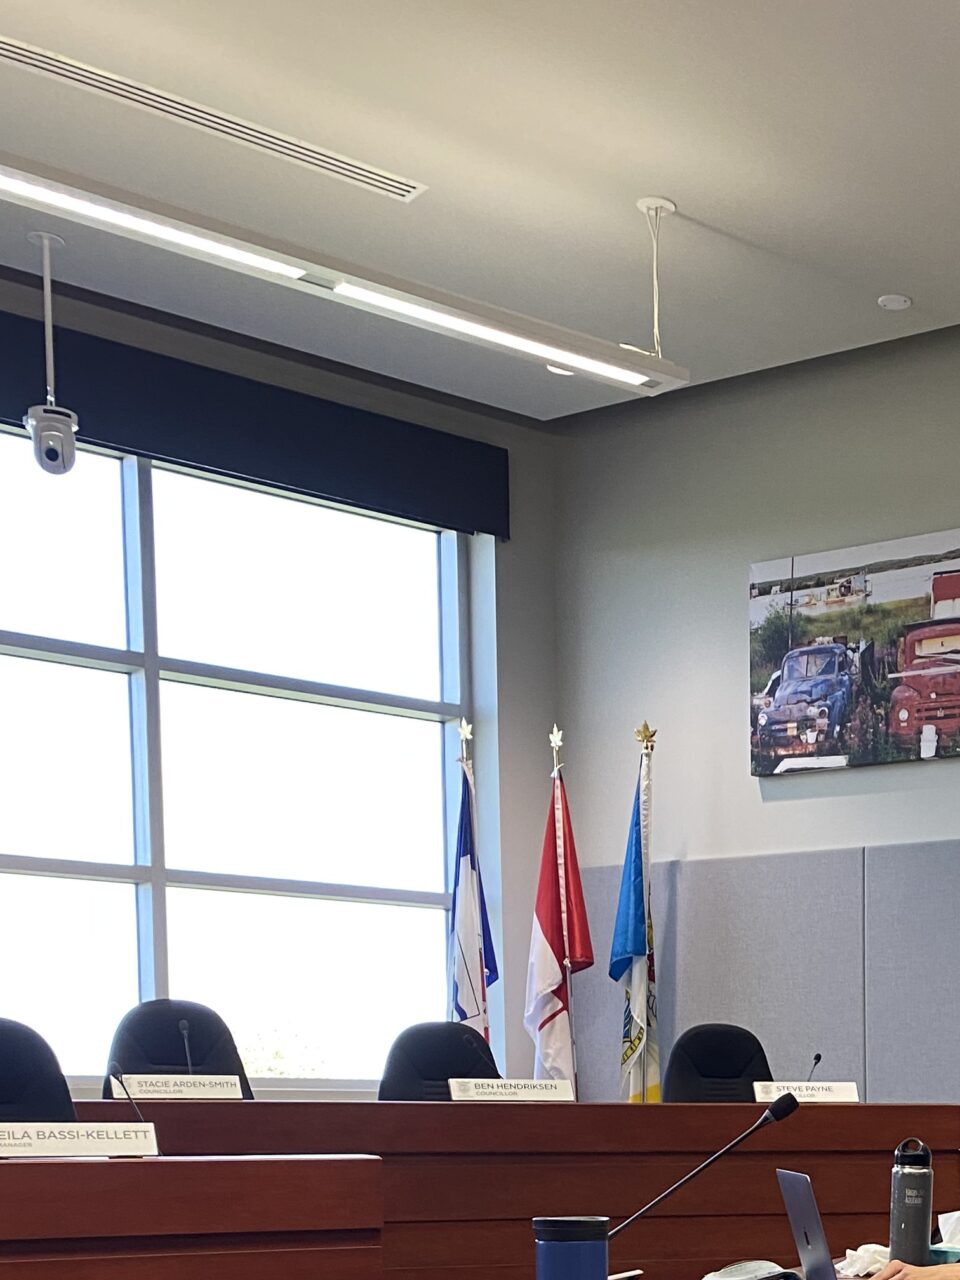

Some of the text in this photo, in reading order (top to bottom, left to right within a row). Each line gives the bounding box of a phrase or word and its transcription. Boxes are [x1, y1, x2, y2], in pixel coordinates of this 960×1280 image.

[137, 1080, 237, 1089] STACIE ARDEN-SMITH
[496, 1083, 558, 1091] HENDRIKSEN
[776, 1085, 834, 1093] STEVE PAYNE
[36, 1130, 150, 1141] BASSI-KELLETT
